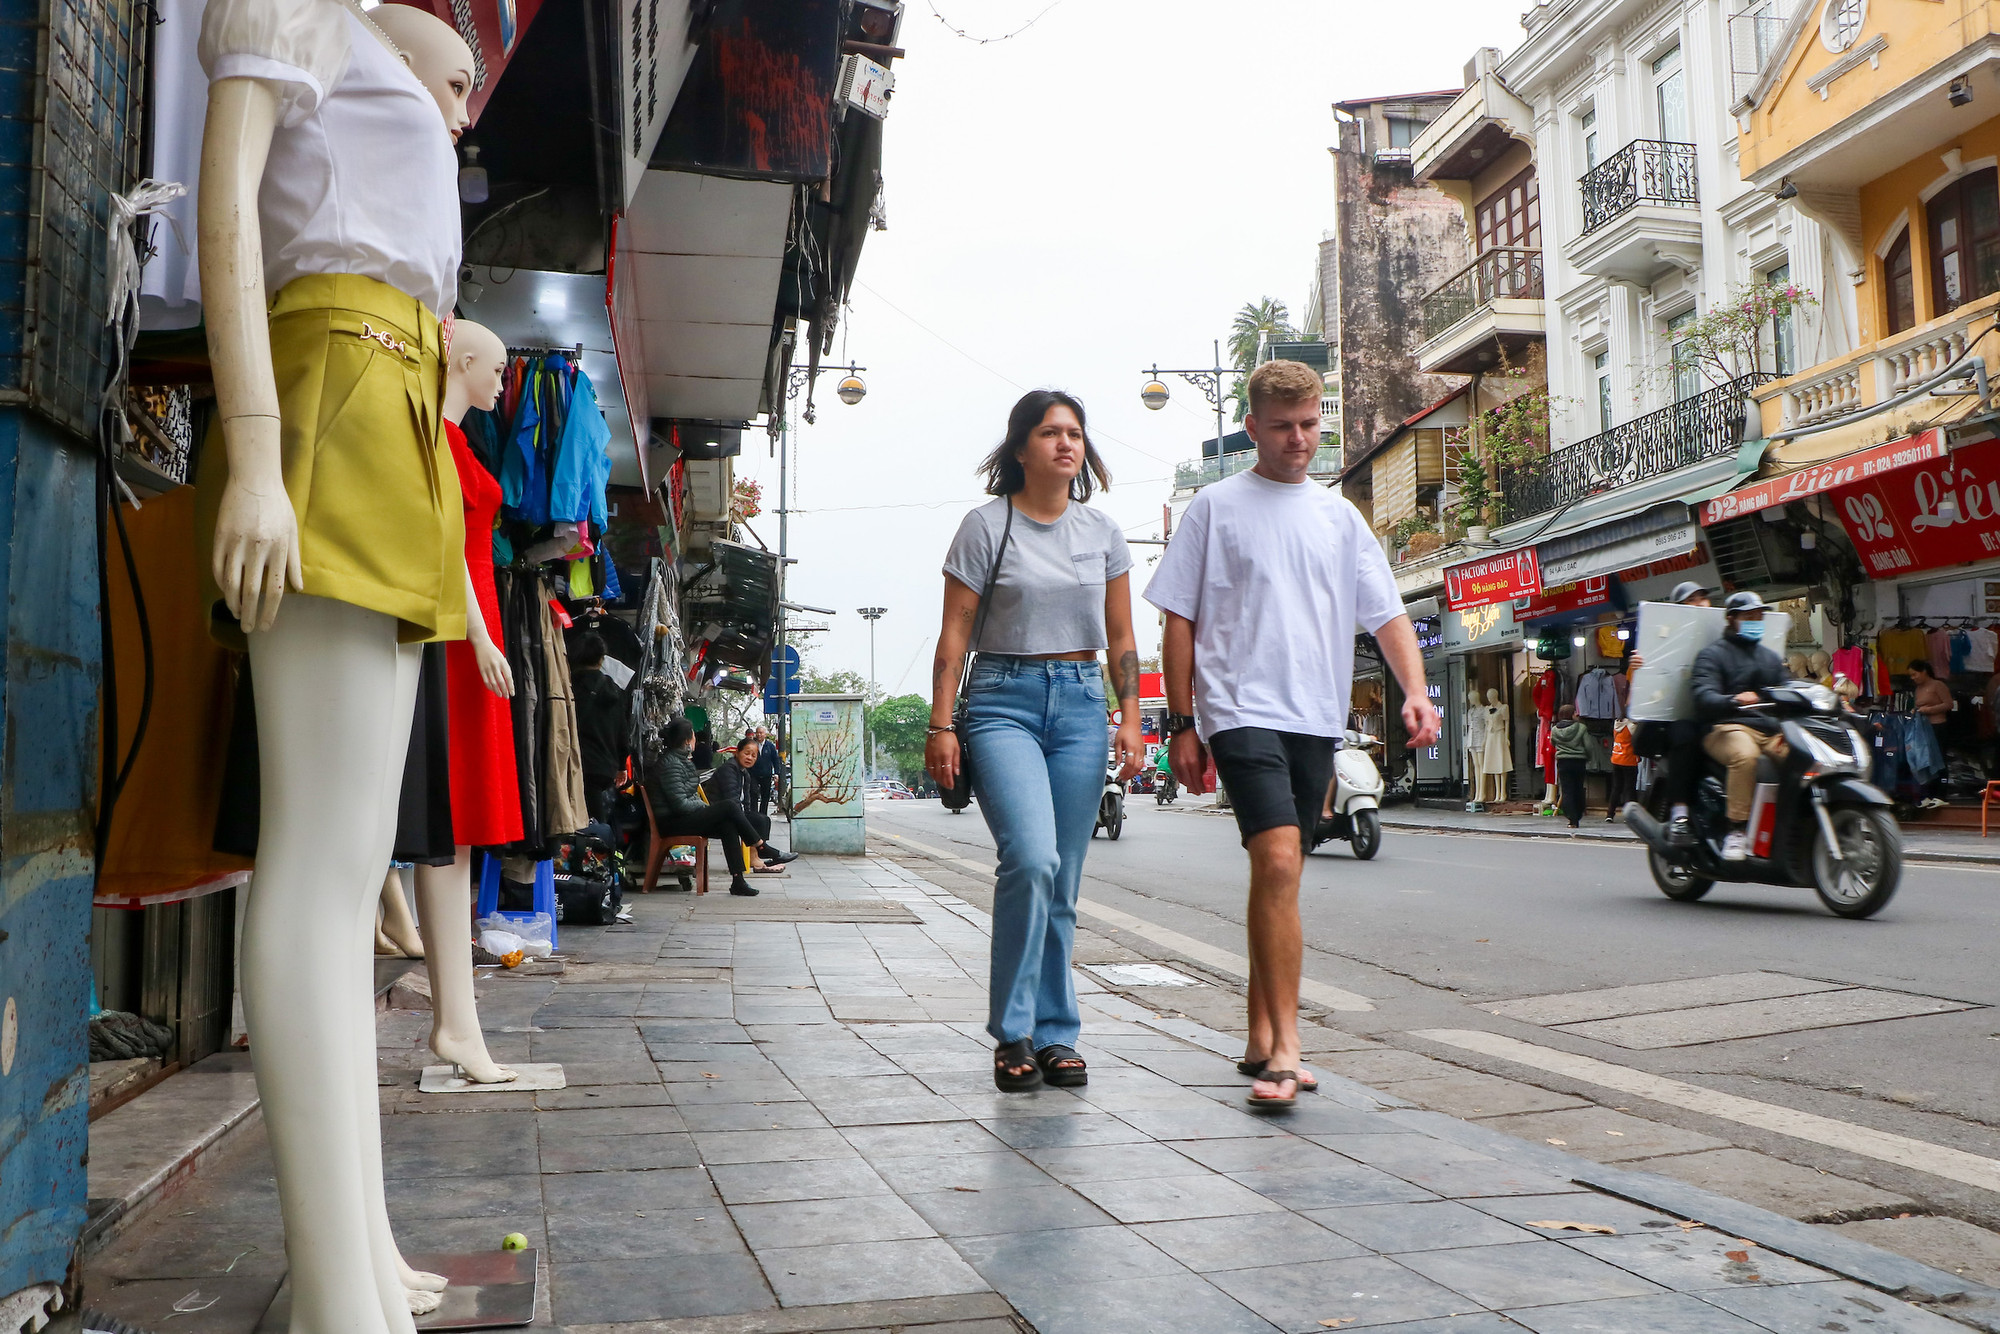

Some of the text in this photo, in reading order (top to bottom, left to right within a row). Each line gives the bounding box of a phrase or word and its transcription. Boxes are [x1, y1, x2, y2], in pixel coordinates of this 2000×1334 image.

[857, 86, 884, 106] 1901515
[1707, 496, 1738, 523] 92
[1779, 466, 1860, 502] Liên
[1877, 456, 1891, 472] 024
[1892, 443, 1932, 467] 39260118
[1845, 493, 1894, 542] 92
[1461, 556, 1515, 581] FACTORY OUTLET
[1471, 582, 1482, 595] 96
